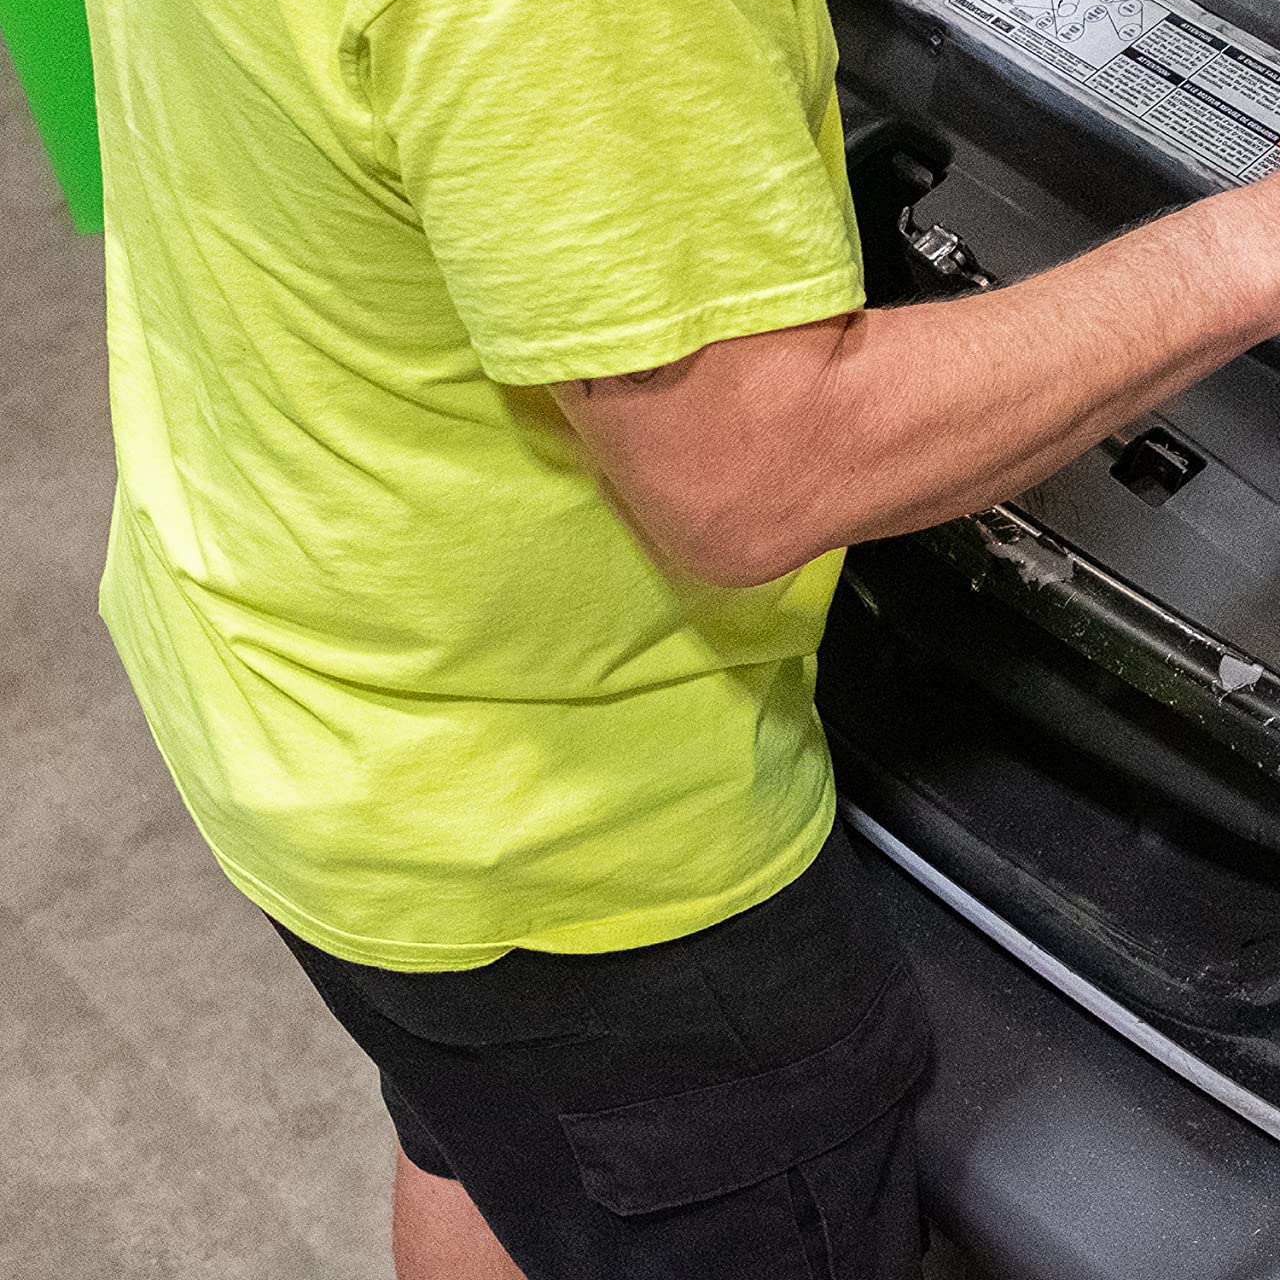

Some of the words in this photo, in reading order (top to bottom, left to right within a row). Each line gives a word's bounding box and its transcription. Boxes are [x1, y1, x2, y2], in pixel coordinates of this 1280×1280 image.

[1179, 21, 1213, 42] ATTENTION
[1242, 57, 1266, 73] ENGINE
[1169, 94, 1207, 118] AUTOMATIQUE
[1196, 90, 1222, 107] MOTEUR
[1218, 103, 1241, 119] REFUSE
[1238, 115, 1250, 124] DE
